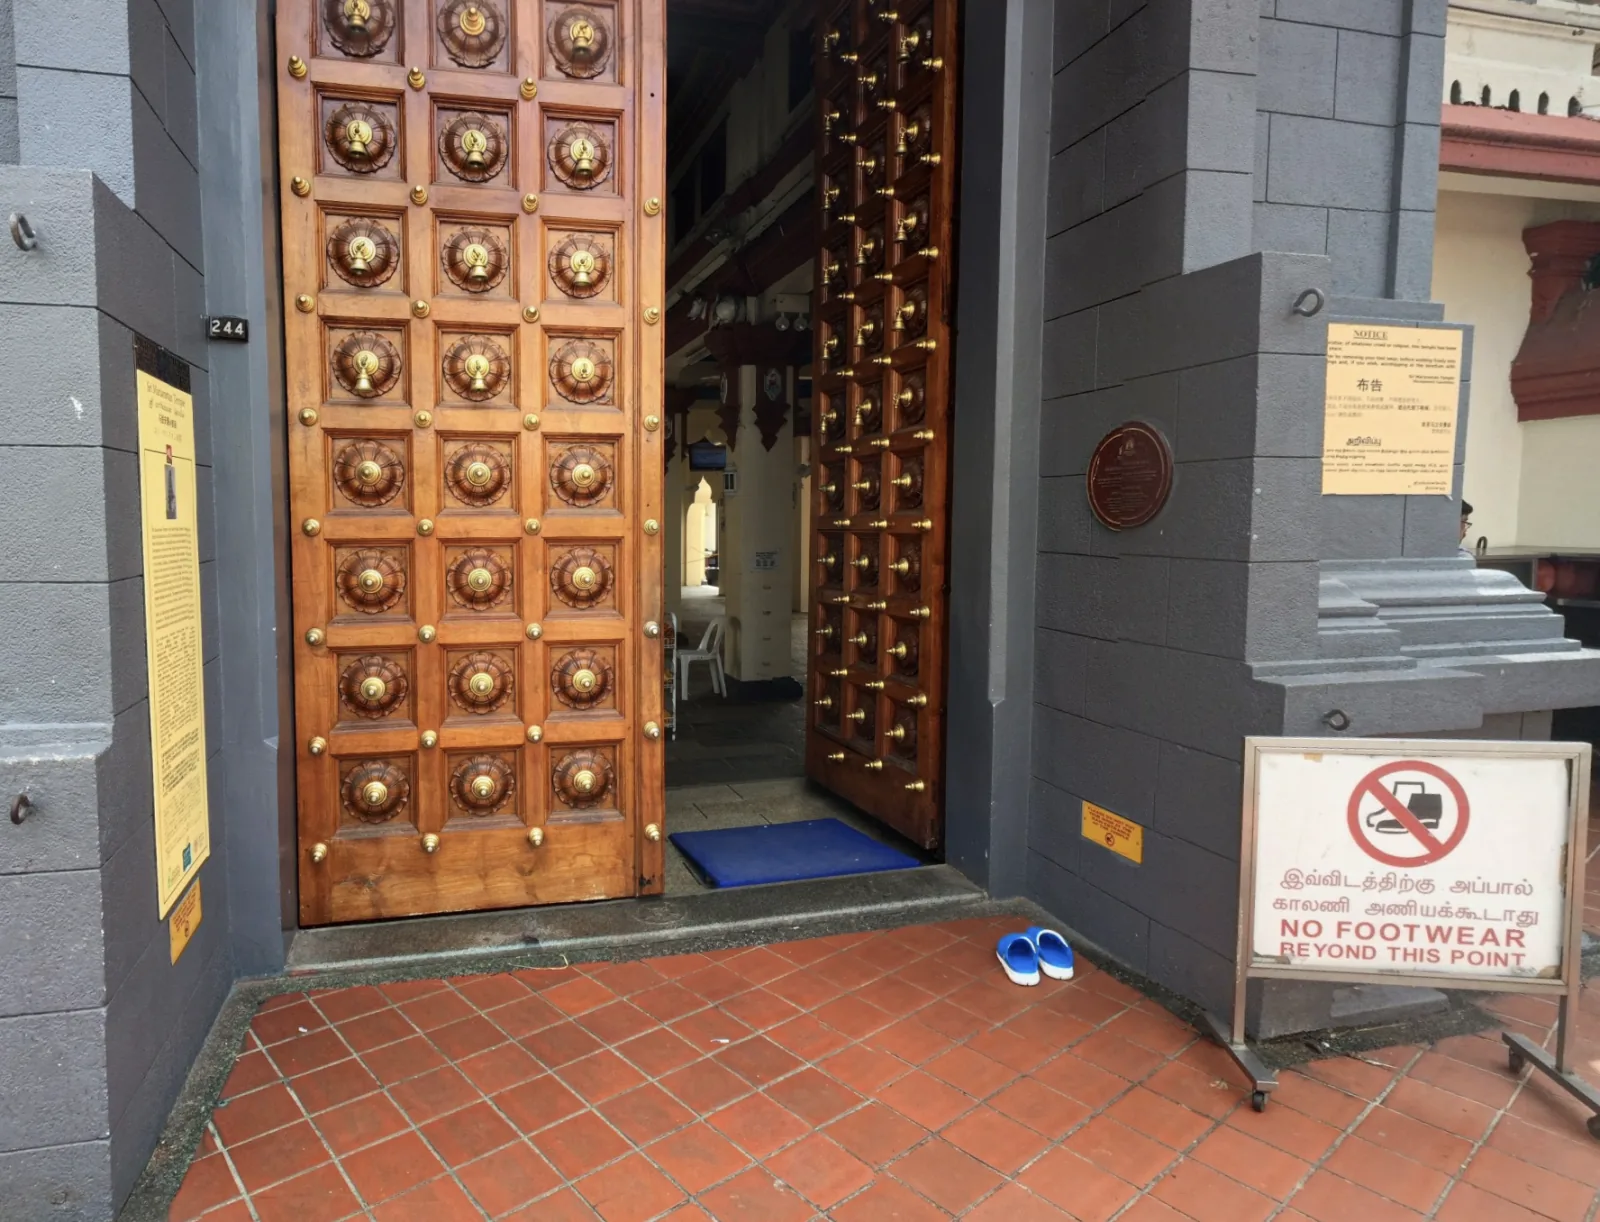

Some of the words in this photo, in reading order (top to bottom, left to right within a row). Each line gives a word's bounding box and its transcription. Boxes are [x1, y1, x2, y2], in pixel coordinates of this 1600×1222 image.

[212, 319, 244, 335] 244
[1353, 330, 1388, 339] NOTICE
[1357, 378, 1383, 393] 布告
[1346, 435, 1382, 447] அறிவிப்பு
[1279, 868, 1436, 895] இவ்விடத்திற்கு
[1449, 876, 1534, 897] அப்பால்
[1272, 896, 1350, 913] காலணி
[1364, 900, 1540, 928] அணியக்கூடாது
[1280, 918, 1323, 939] NO
[1337, 920, 1526, 948] FOOTWEAR
[1280, 941, 1377, 960] BEYOND
[1386, 946, 1441, 964] THIS
[1450, 949, 1526, 968] POINT
